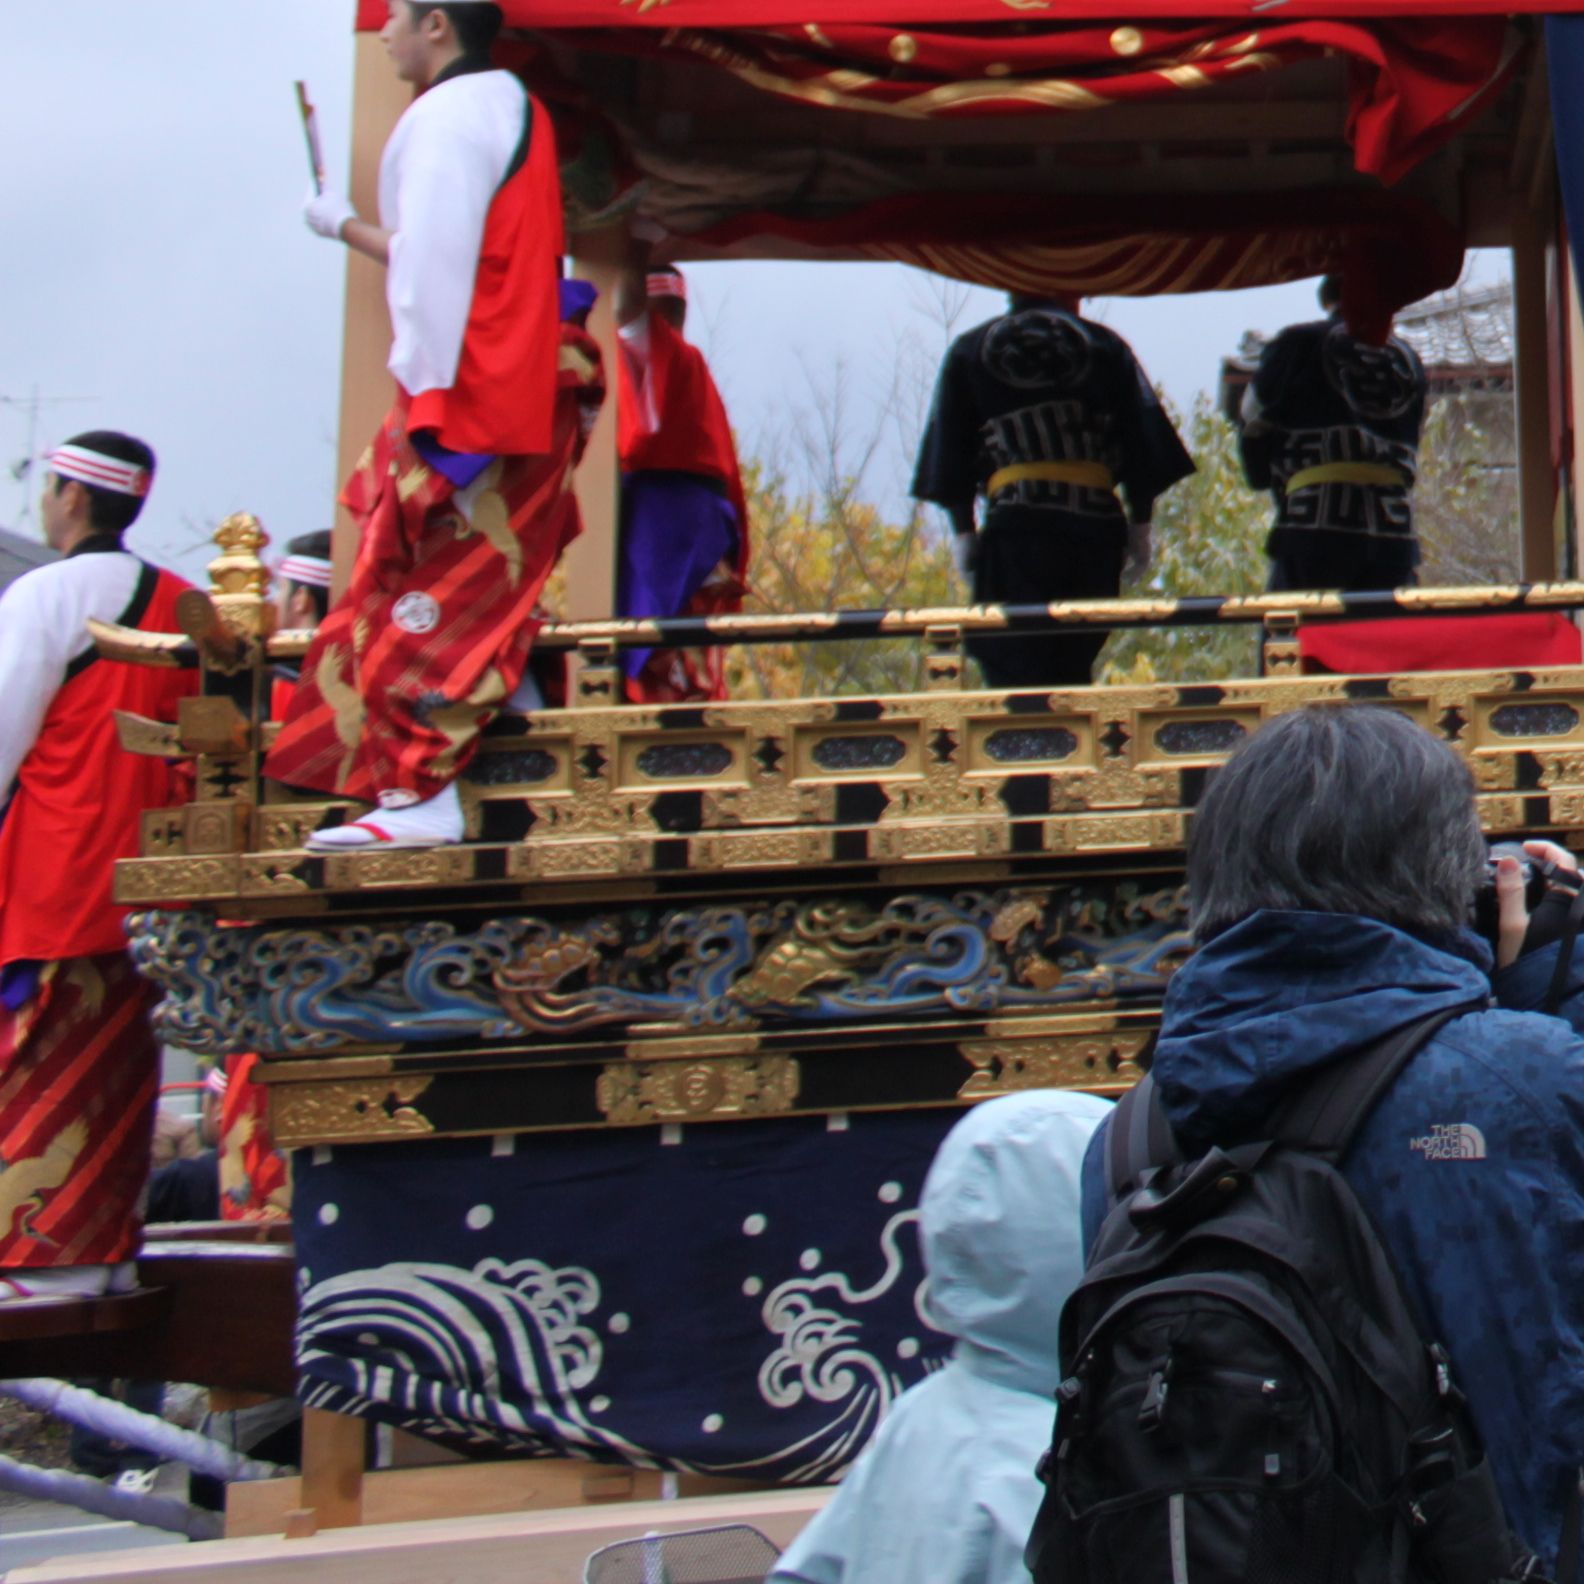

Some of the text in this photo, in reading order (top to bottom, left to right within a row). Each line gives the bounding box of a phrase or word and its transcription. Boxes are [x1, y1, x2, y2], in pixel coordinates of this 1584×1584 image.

[1430, 1124, 1459, 1136] THE
[1409, 1136, 1460, 1151] NORTH
[1425, 1147, 1460, 1160] FACE
